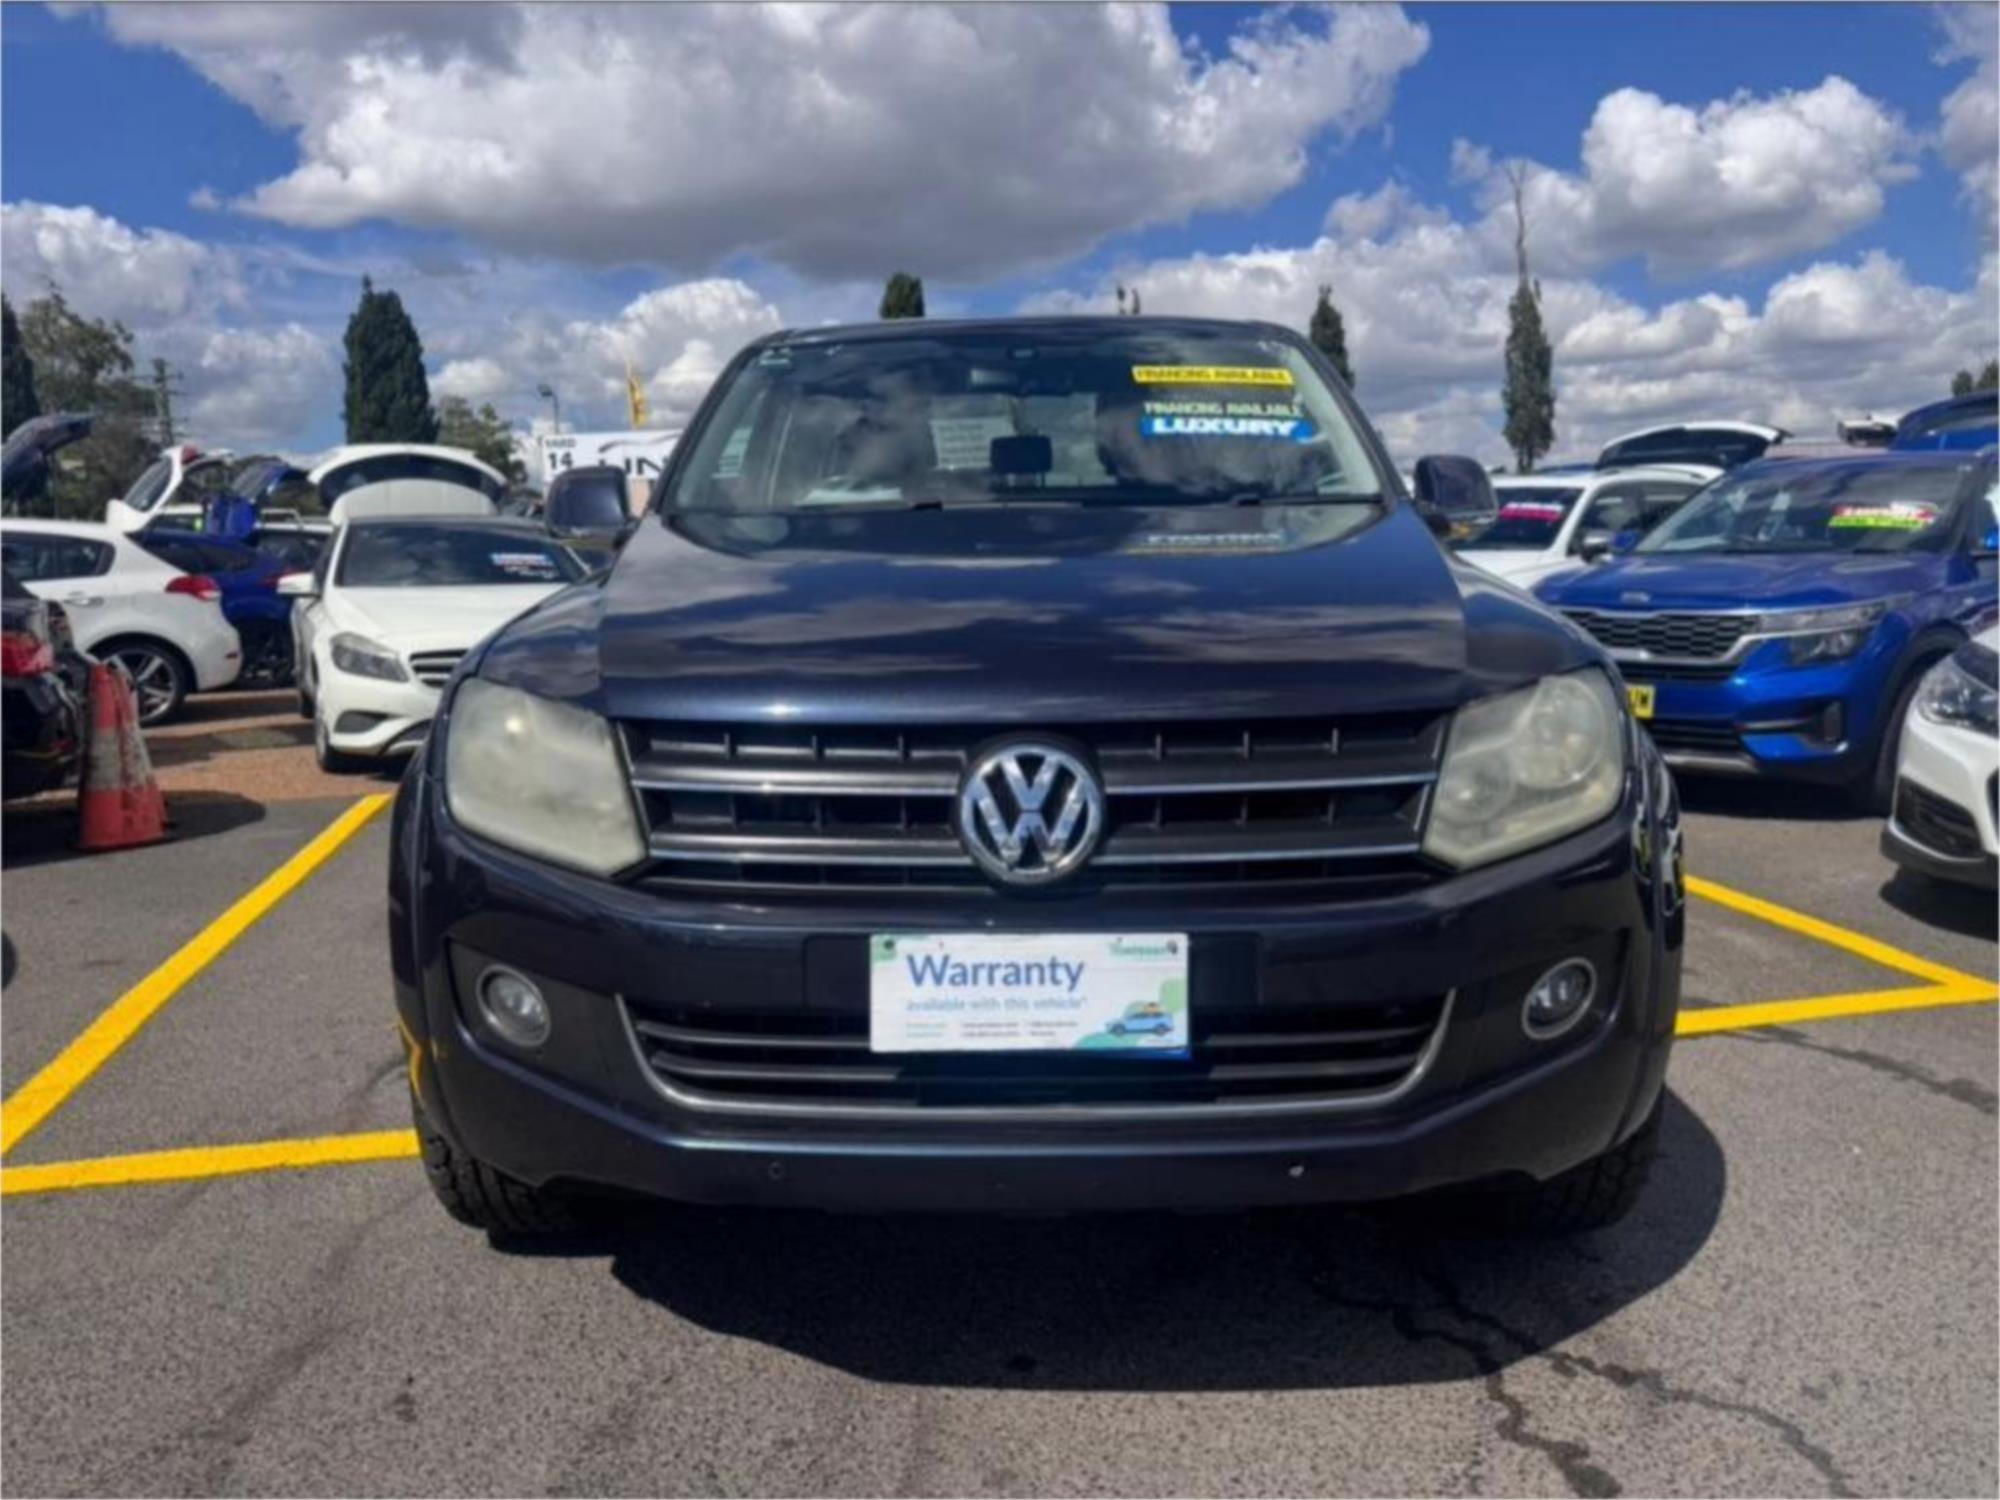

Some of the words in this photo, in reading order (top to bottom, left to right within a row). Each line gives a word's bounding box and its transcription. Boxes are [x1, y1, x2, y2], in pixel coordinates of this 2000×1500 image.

[1152, 416, 1298, 435] LUXURY
[549, 452, 573, 469] 14
[906, 953, 1085, 991] Warranty
[906, 997, 965, 1012] available
[970, 996, 1000, 1011] with
[1003, 996, 1029, 1011] this
